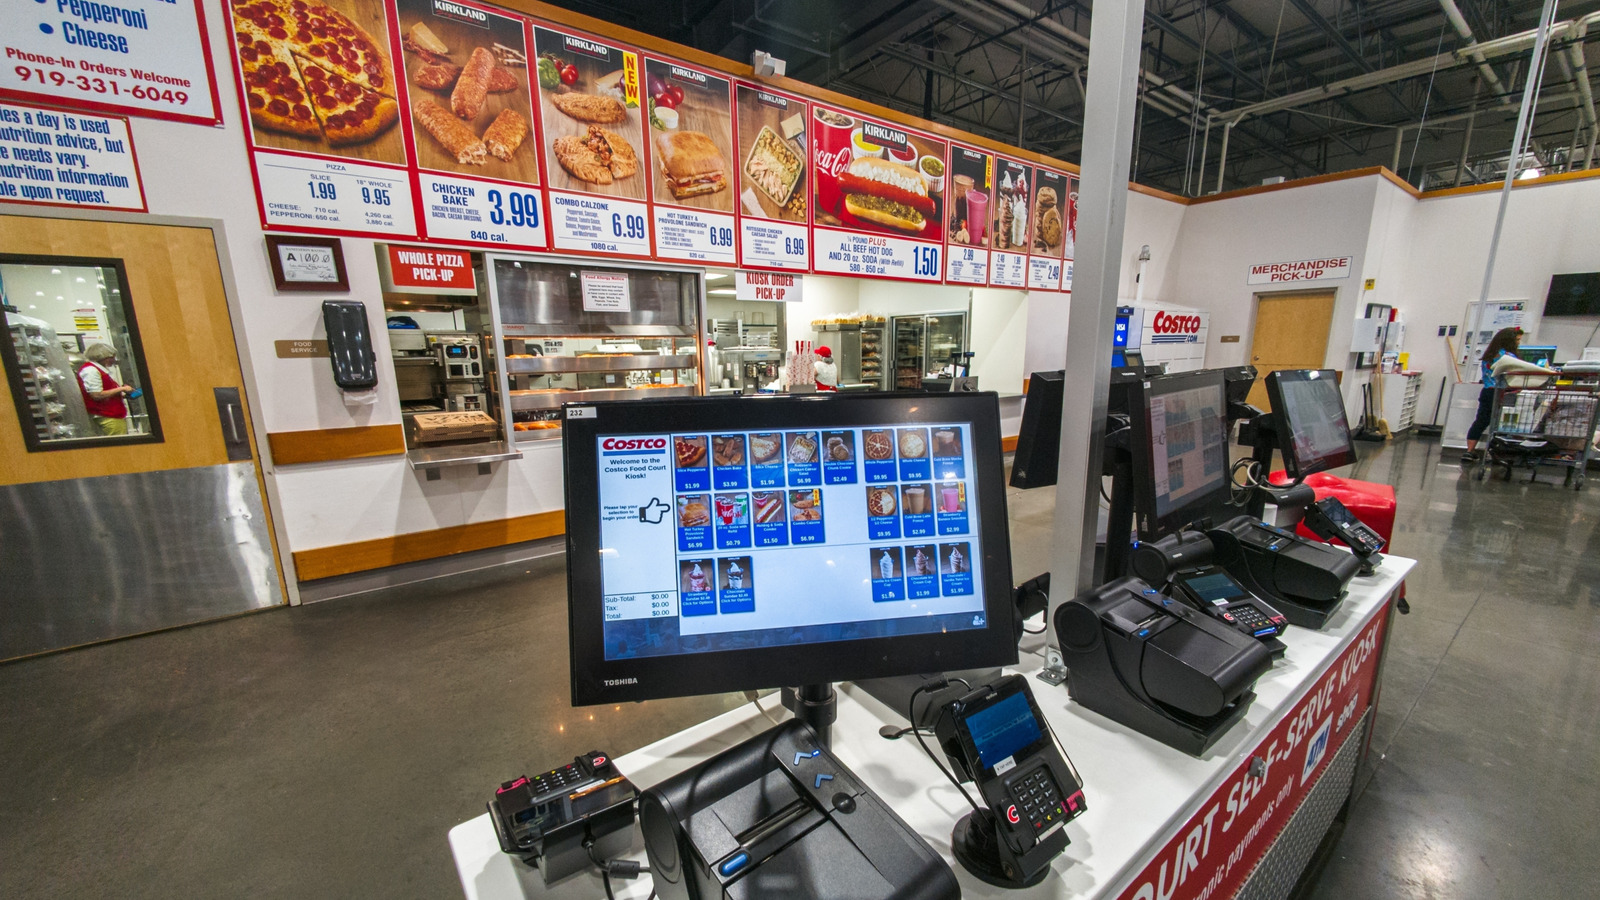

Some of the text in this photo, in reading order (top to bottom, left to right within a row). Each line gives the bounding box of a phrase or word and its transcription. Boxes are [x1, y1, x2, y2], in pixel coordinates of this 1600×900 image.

[57, 0, 148, 30] Pepperoni
[435, 0, 486, 21] KIRKLAND
[62, 20, 129, 53] Cheese
[565, 36, 607, 56] KIRKLAND
[5, 47, 191, 88] Phone-In Orders Welcome
[672, 66, 706, 83] KIRKLAND
[14, 65, 189, 106] 919-331-6049
[626, 56, 638, 99] NEW
[758, 92, 787, 107] KIRKLAND
[24, 111, 33, 125] a
[36, 111, 60, 131] day
[63, 114, 77, 131] is
[80, 118, 110, 135] used
[864, 123, 906, 144] KIRKLAND
[55, 132, 102, 153] advice,
[104, 136, 125, 154] but
[12, 147, 53, 164] needs
[55, 152, 89, 169] vary.
[326, 163, 346, 172] PIZZA
[57, 167, 129, 189] information
[310, 174, 331, 182] SLICE
[368, 180, 393, 189] WHOLE
[20, 184, 53, 200] upon
[56, 187, 110, 205] request.
[308, 181, 337, 200] 1.99
[361, 187, 391, 206] 9.95
[432, 182, 475, 197] CHICKEN
[269, 202, 301, 211] CHEESE:
[442, 195, 468, 206] BAKE
[488, 189, 539, 228] 3.99
[555, 197, 609, 211] COMBO CALZONE
[270, 210, 315, 220] PEPPERONI:
[612, 213, 645, 239] 6.99
[471, 230, 508, 242] 840 cal.
[710, 227, 732, 247] 6.99
[852, 236, 867, 244] POUND
[868, 237, 886, 246] PLUS
[786, 237, 804, 255] 6.99
[840, 243, 893, 256] ALL BEEF HOT DOG
[287, 252, 297, 261] A
[398, 251, 464, 268] WHOLE PIZZA
[829, 252, 841, 261] AND
[843, 253, 850, 262] 20
[862, 254, 877, 264] SODA
[913, 246, 938, 276] 1.50
[413, 267, 454, 282] PICK-UP
[850, 263, 860, 271] 580
[866, 265, 876, 273] 850
[877, 266, 886, 274] cal.
[1252, 258, 1347, 275] MERCHANDISE
[747, 272, 794, 287] KIOSK ORDER
[1271, 269, 1323, 282] PICK-UP
[756, 287, 785, 300] PICK-UP
[1153, 310, 1201, 333] COSTCO
[603, 438, 666, 450] COSTCO
[605, 595, 636, 603] Sub-Total:
[1338, 620, 1380, 694] KIOSK
[604, 677, 638, 687] TOSHIBA
[1304, 724, 1330, 775] ATM
[1225, 800, 1275, 878] payments
[1275, 774, 1295, 808] only
